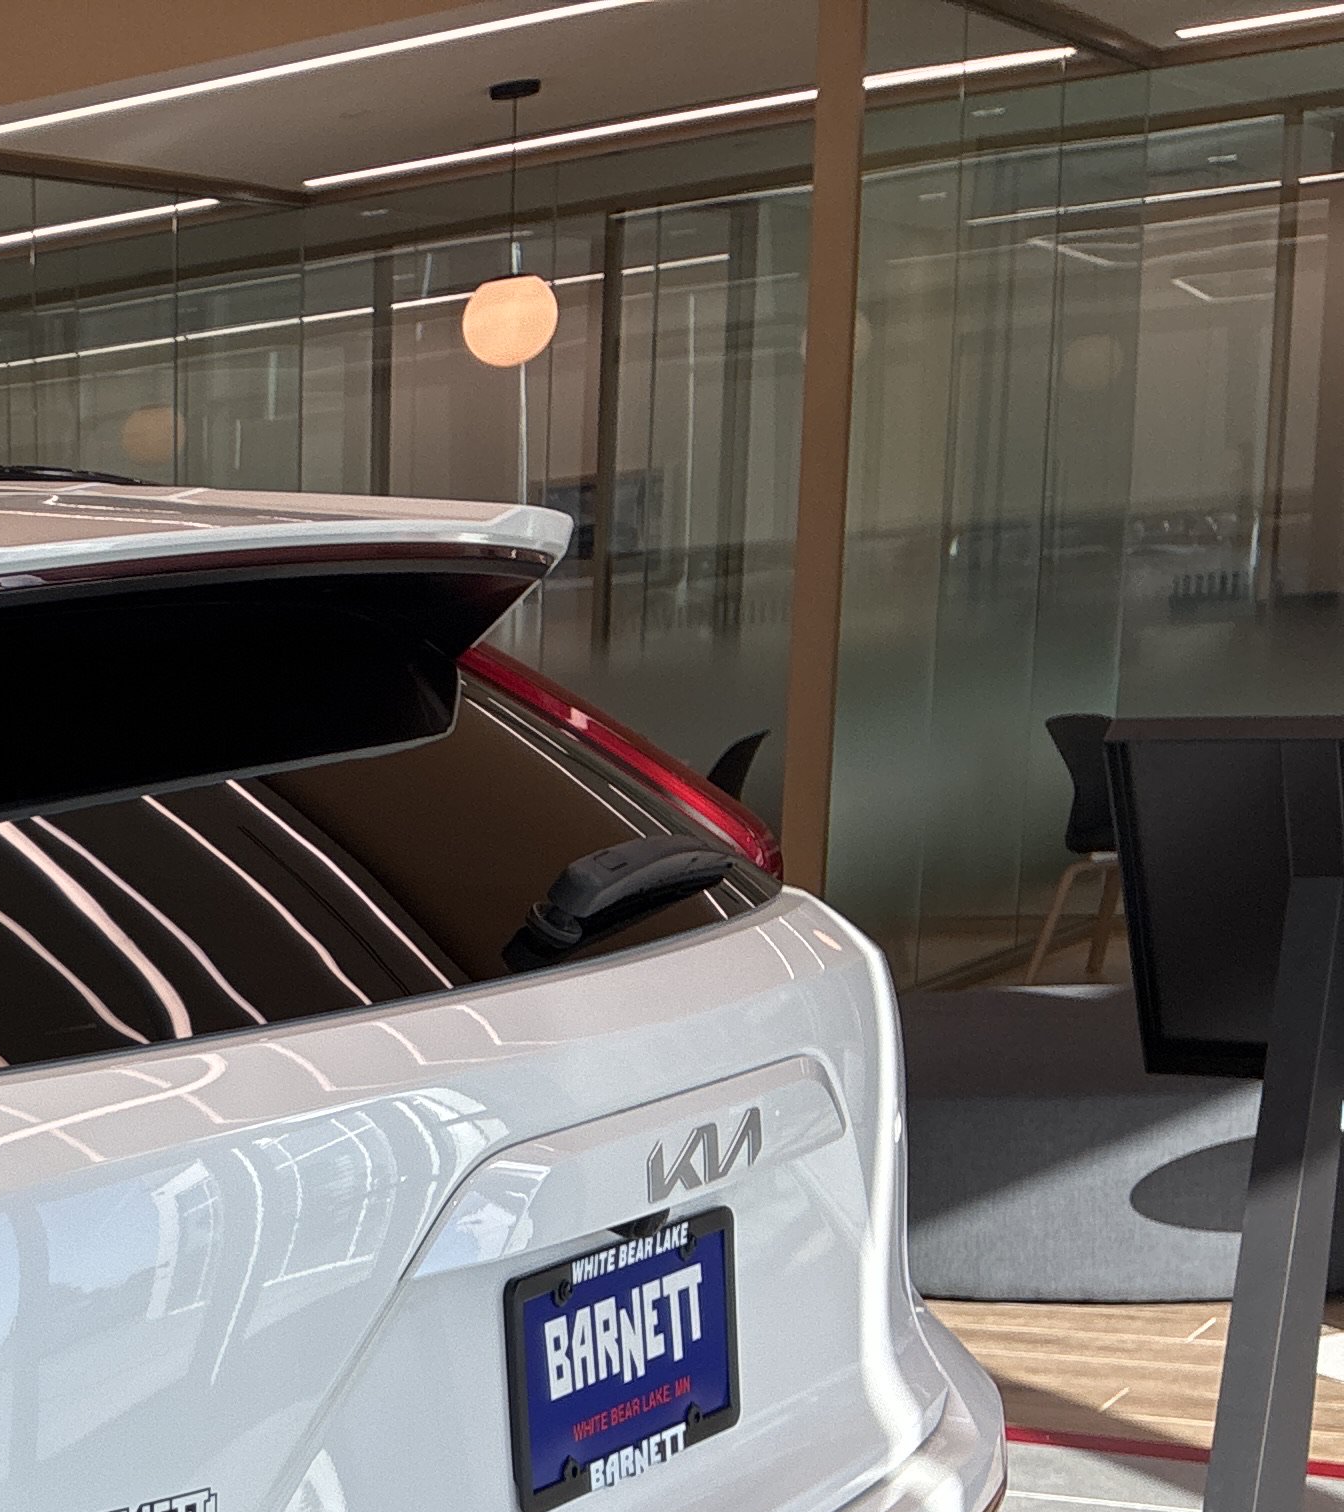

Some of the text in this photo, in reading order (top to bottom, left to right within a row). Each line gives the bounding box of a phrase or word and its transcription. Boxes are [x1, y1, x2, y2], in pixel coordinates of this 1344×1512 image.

[646, 1106, 762, 1203] KIA
[572, 1221, 689, 1285] WHITE BEAR LAKE
[544, 1262, 702, 1401] BARNETT
[573, 1411, 609, 1442] WHITE
[610, 1397, 641, 1426] BEAR
[674, 1375, 692, 1398] MN
[589, 1421, 687, 1491] BARNETT
